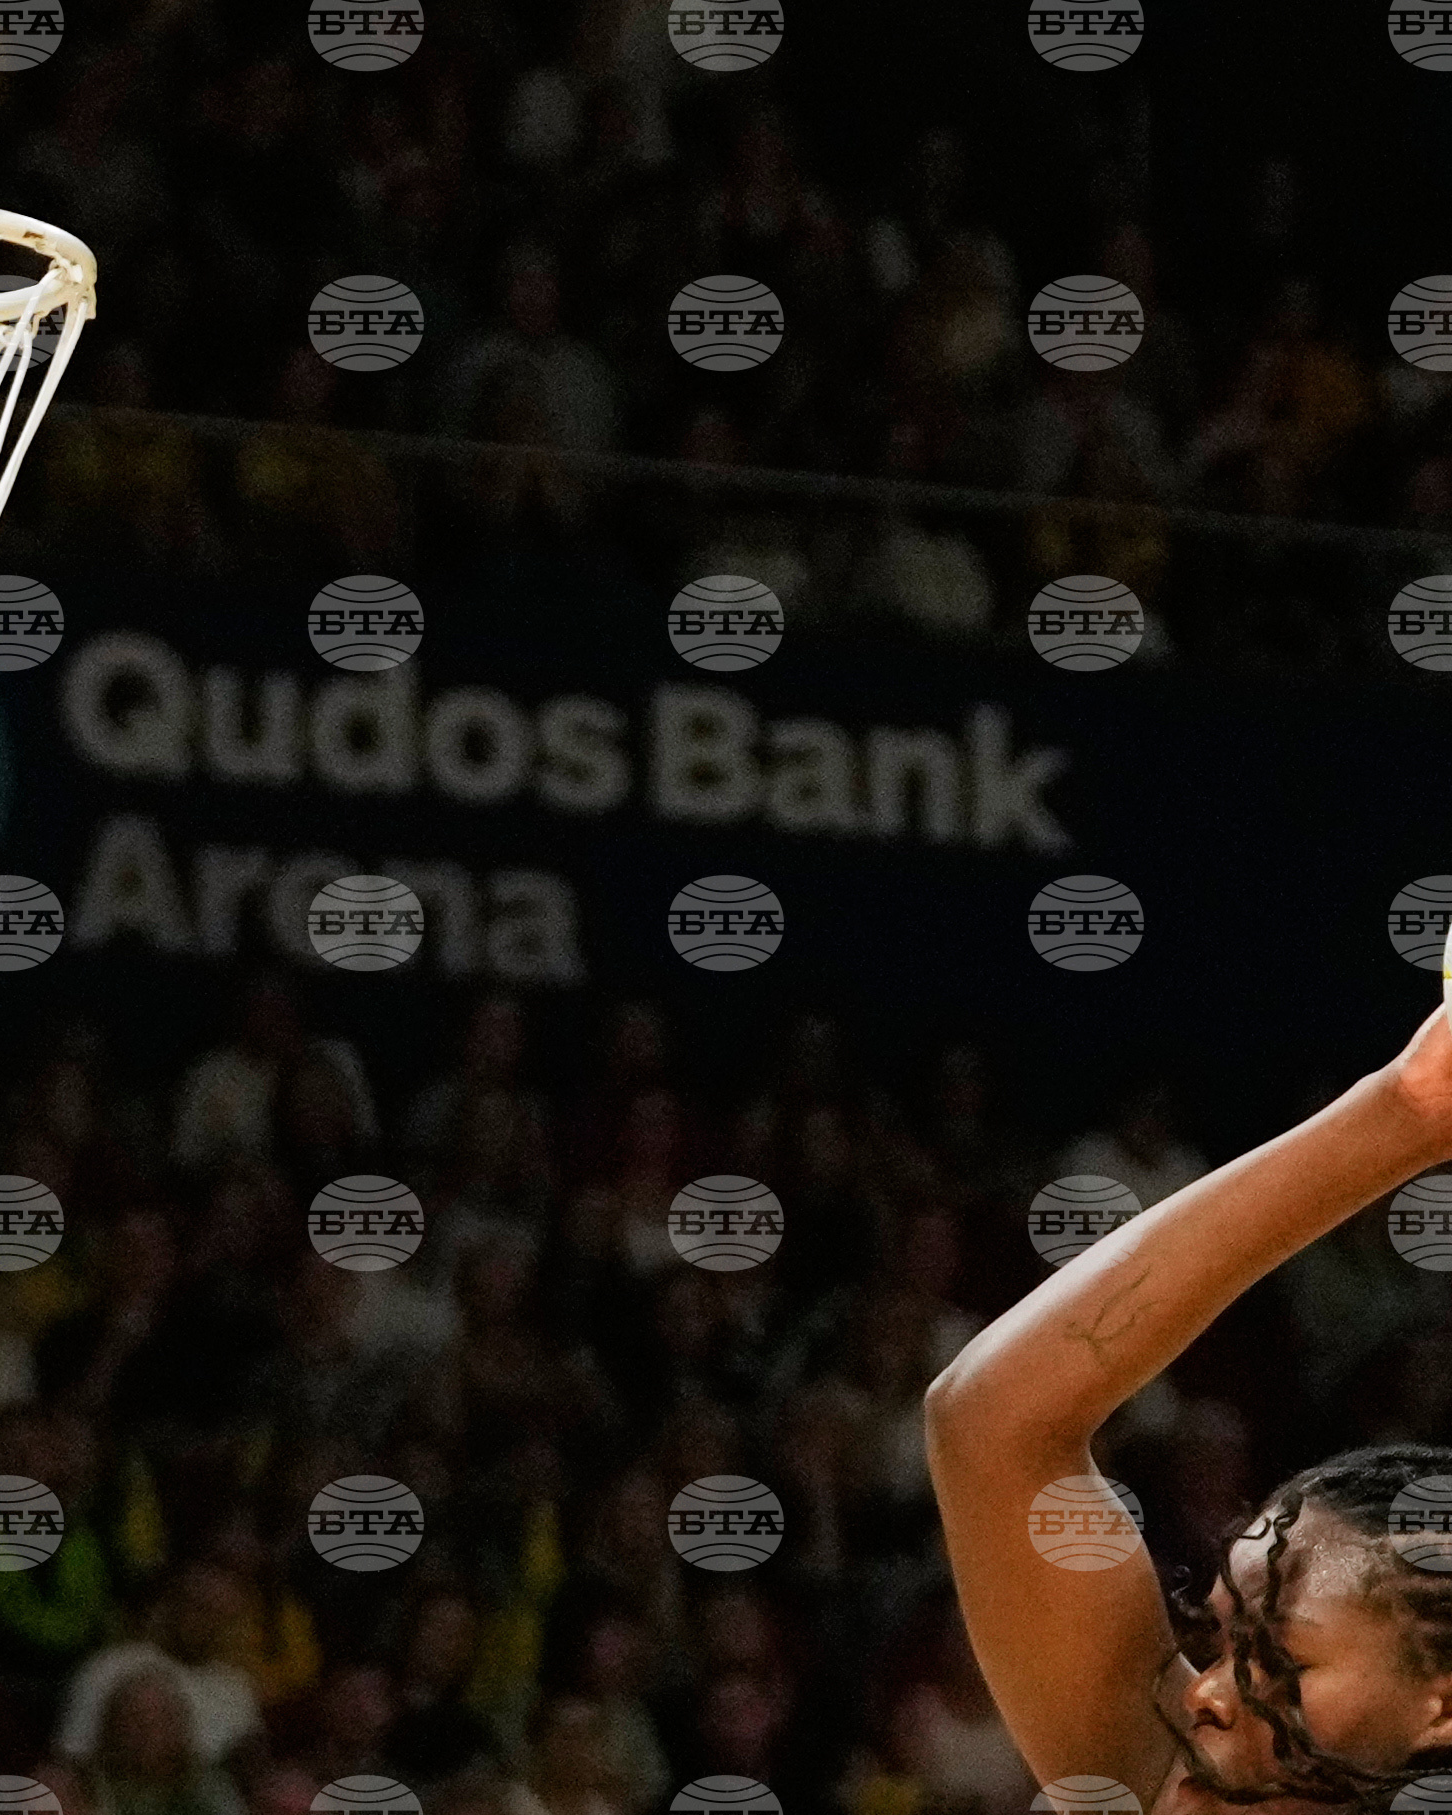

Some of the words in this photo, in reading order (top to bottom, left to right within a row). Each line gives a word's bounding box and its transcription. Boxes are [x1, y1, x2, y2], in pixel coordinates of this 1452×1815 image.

[60, 630, 632, 812] Qudos
[646, 677, 1072, 854] Bank
[68, 810, 588, 986] Arena
